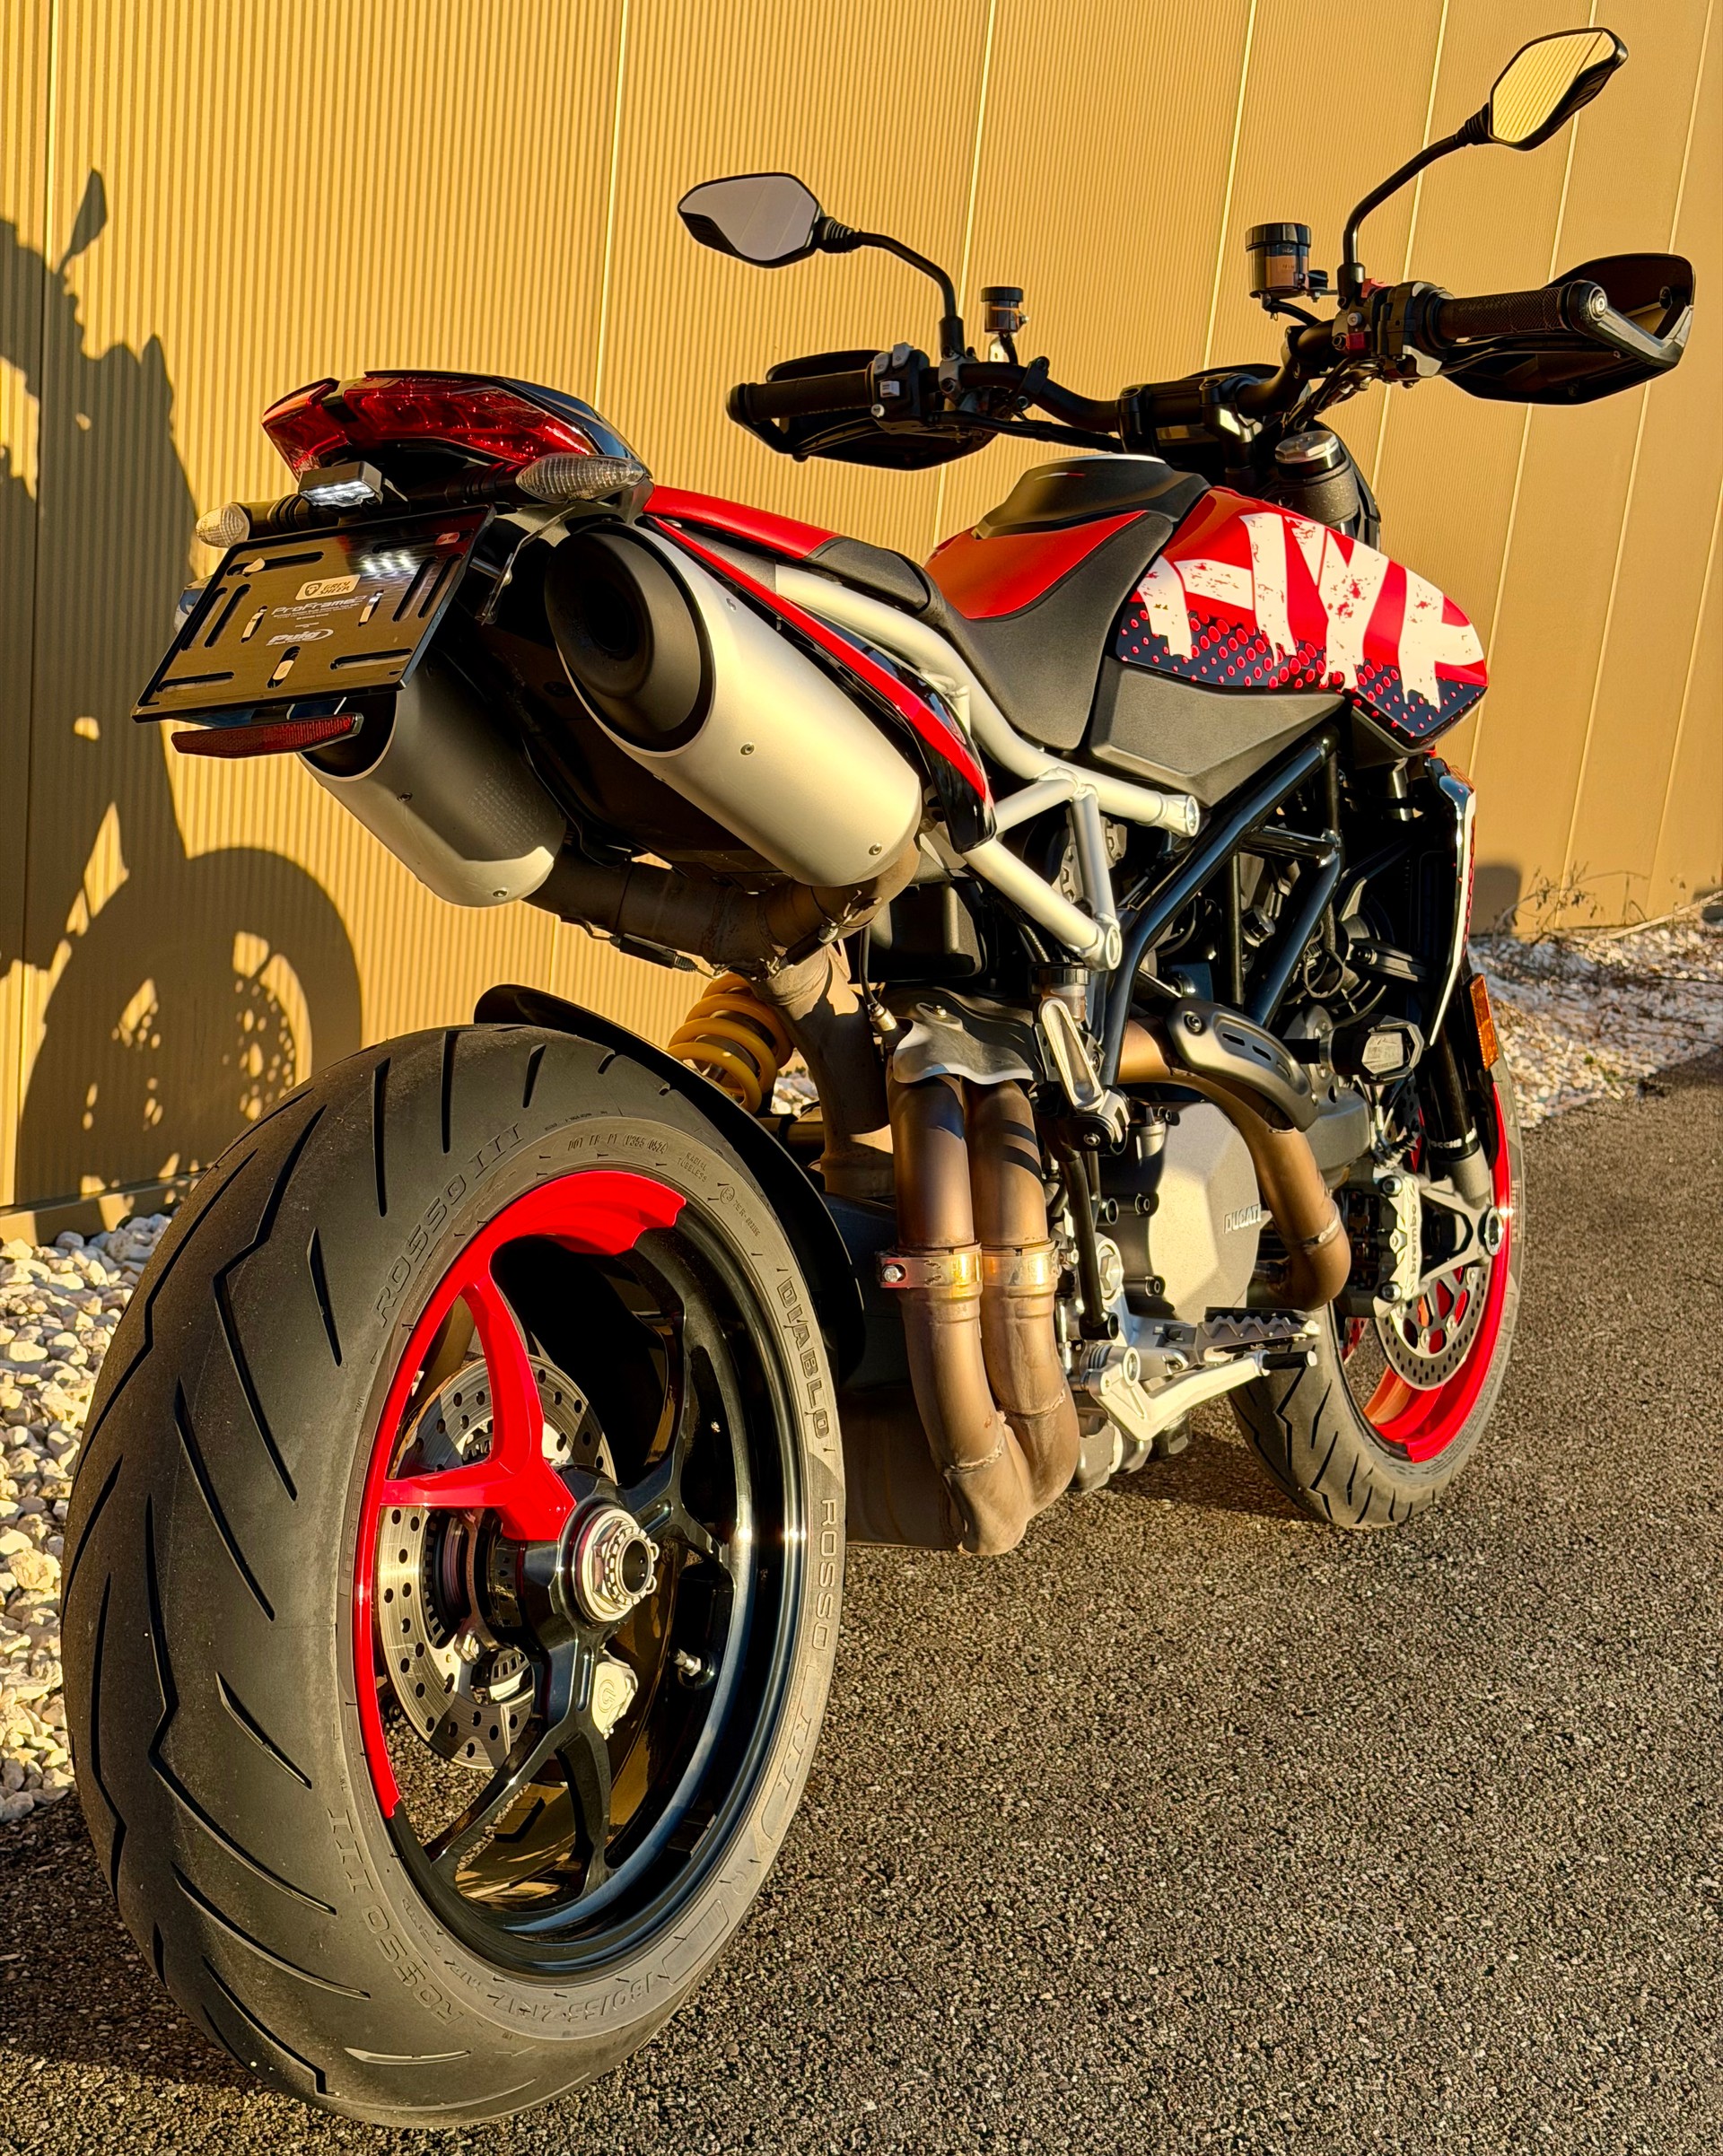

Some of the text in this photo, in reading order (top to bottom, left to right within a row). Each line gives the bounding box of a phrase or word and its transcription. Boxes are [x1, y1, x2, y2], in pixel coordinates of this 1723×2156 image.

[267, 630, 323, 645] Puig
[677, 1157, 708, 1183] TUBELESS
[686, 1152, 708, 1172] RADIAL
[372, 1173, 468, 1328] ROSSO
[467, 1122, 524, 1180] III
[1223, 1203, 1263, 1235] DUCATI
[1410, 1203, 1418, 1275] brembo
[775, 1275, 831, 1440] DIABLO
[812, 1498, 837, 1651] ROSSO
[362, 1904, 464, 2027] ROSSO
